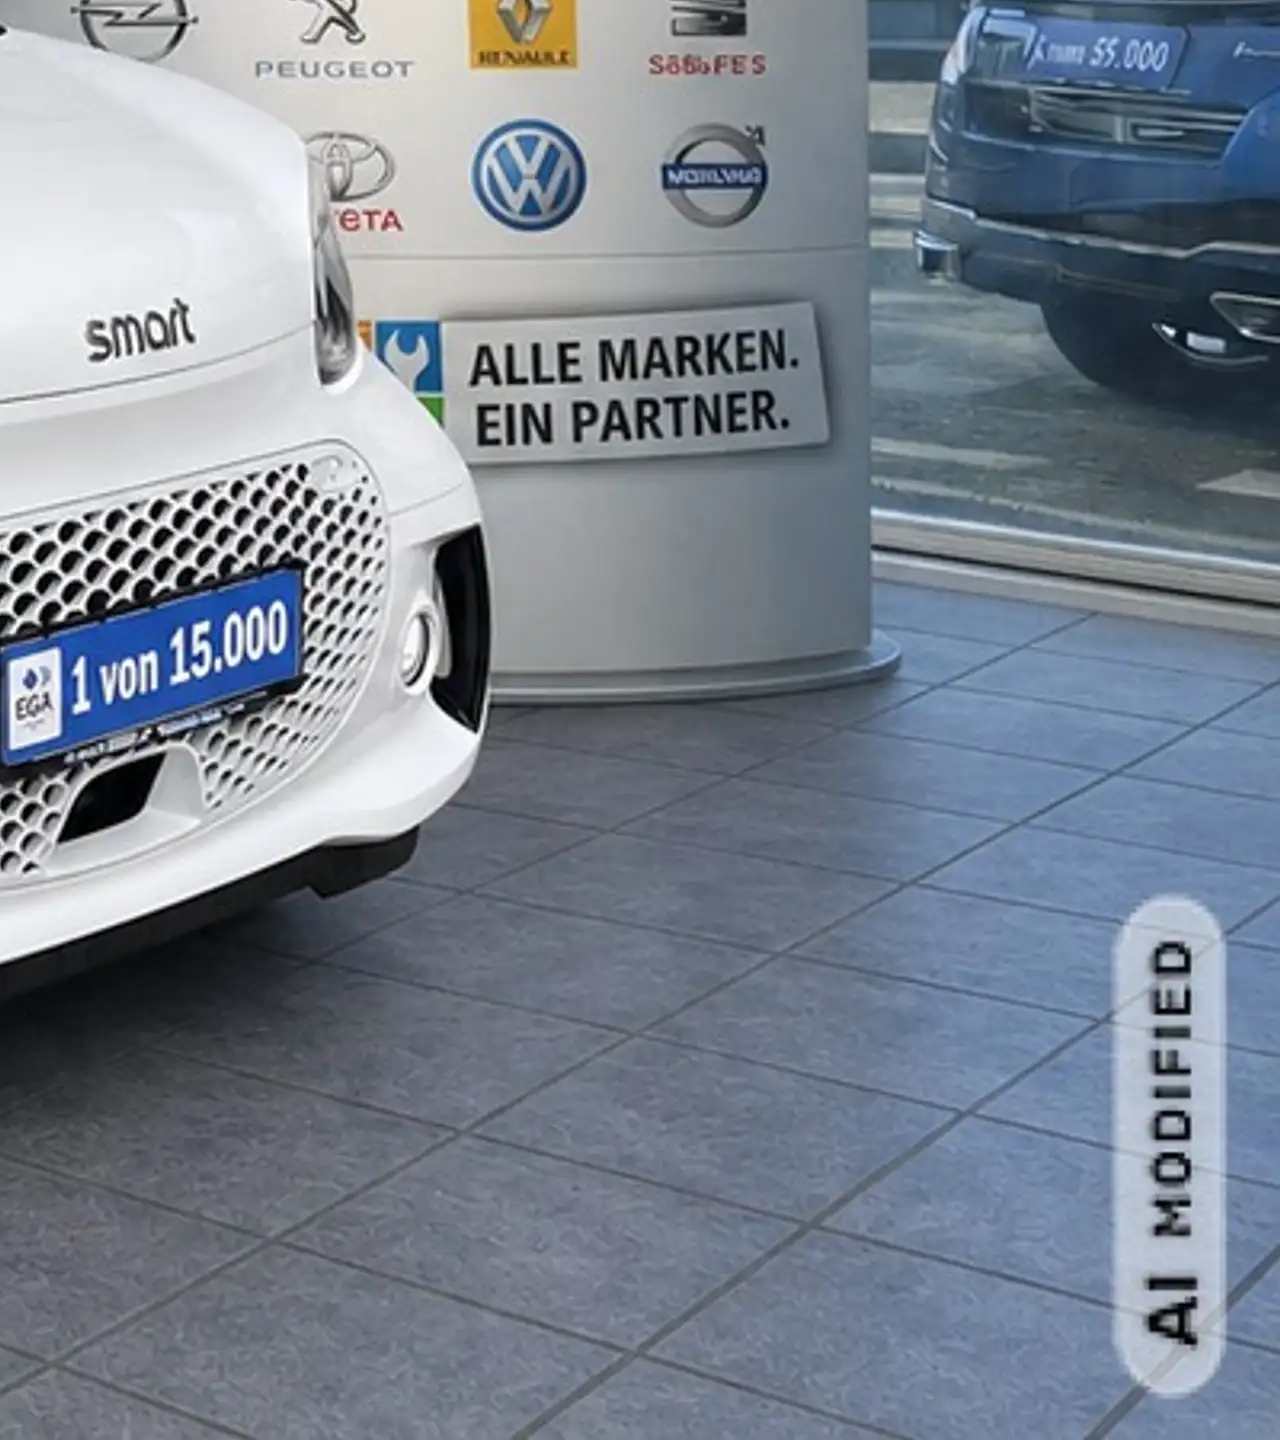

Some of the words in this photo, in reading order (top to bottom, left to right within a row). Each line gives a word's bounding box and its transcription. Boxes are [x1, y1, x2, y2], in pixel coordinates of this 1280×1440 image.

[255, 60, 415, 79] PEUGEOT
[84, 297, 197, 363] smart
[469, 341, 582, 388] ALLE
[598, 328, 799, 383] MARKEN.
[476, 403, 553, 447] EIN
[571, 389, 791, 444] PARTNER.
[71, 656, 91, 715] 1
[100, 649, 159, 705] von
[169, 600, 288, 686] 15.000
[15, 692, 54, 721] EGA
